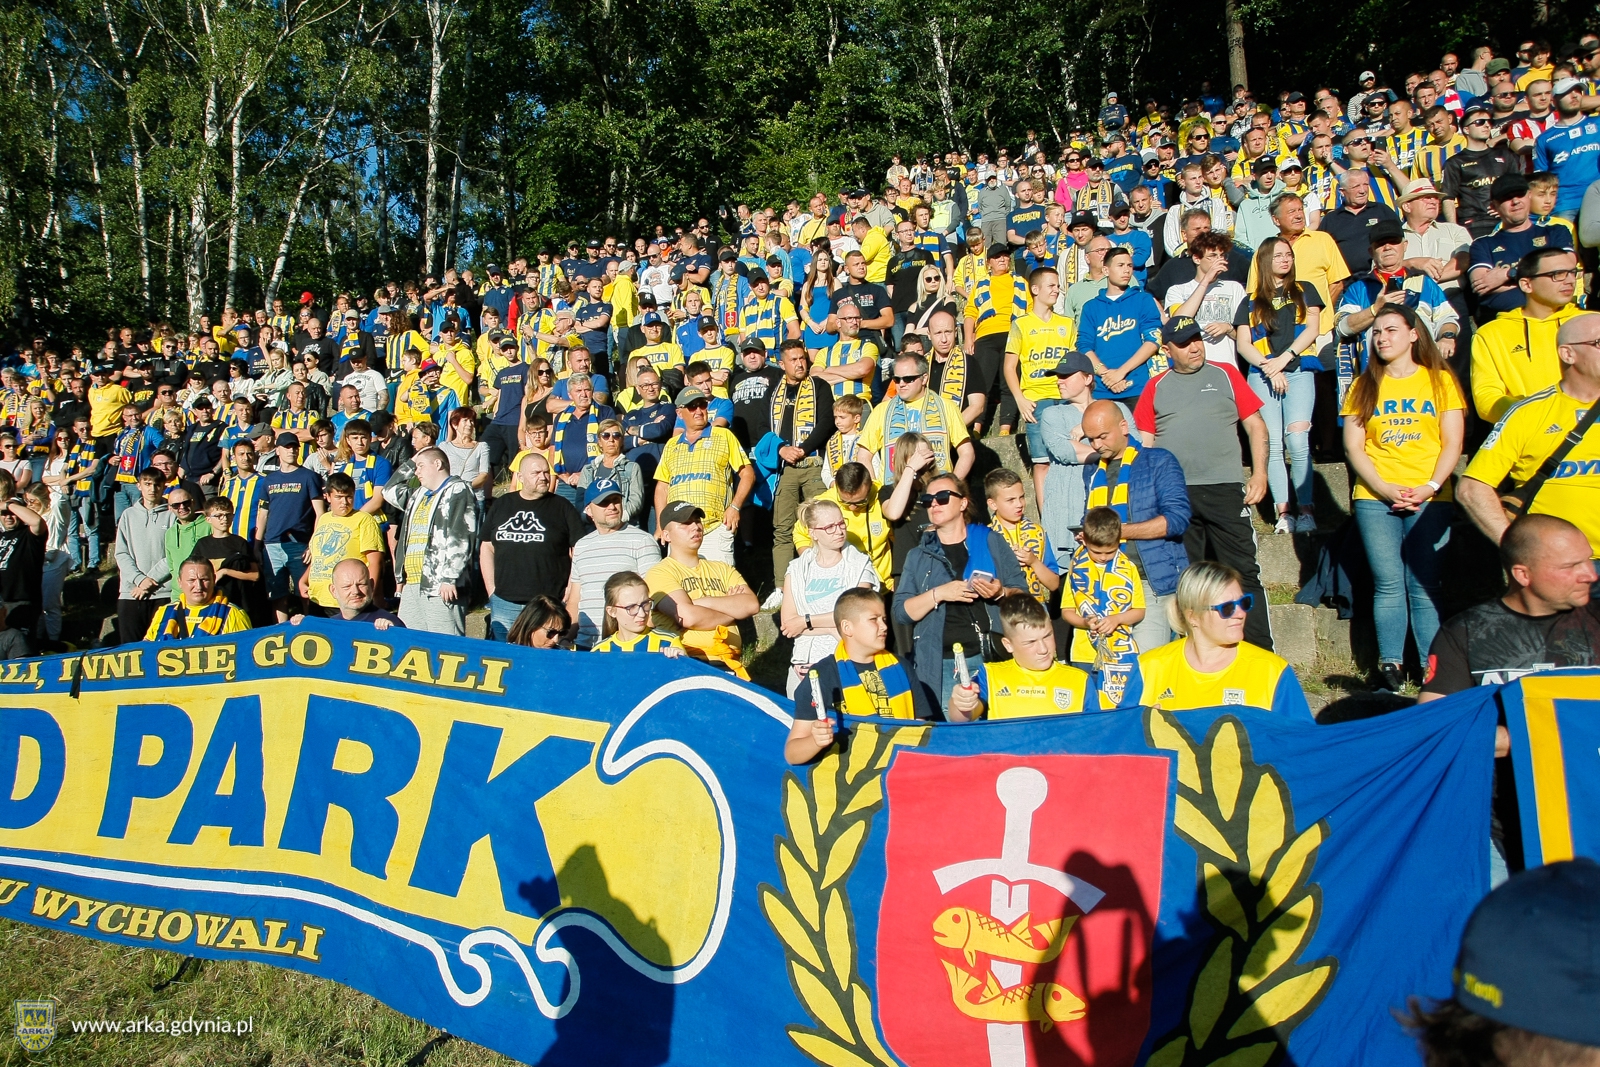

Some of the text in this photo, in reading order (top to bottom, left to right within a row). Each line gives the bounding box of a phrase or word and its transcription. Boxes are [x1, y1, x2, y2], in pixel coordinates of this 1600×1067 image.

[1097, 315, 1136, 341] Arka
[648, 353, 669, 364] RKA
[1380, 429, 1421, 446] Gdynia
[496, 530, 545, 543] Kappa
[806, 578, 840, 592] NIKE
[157, 643, 236, 682] SIĘ
[253, 634, 332, 668] GO
[349, 640, 511, 694] BALI
[97, 694, 596, 921] PARK
[31, 886, 324, 963] WYCHOWALI
